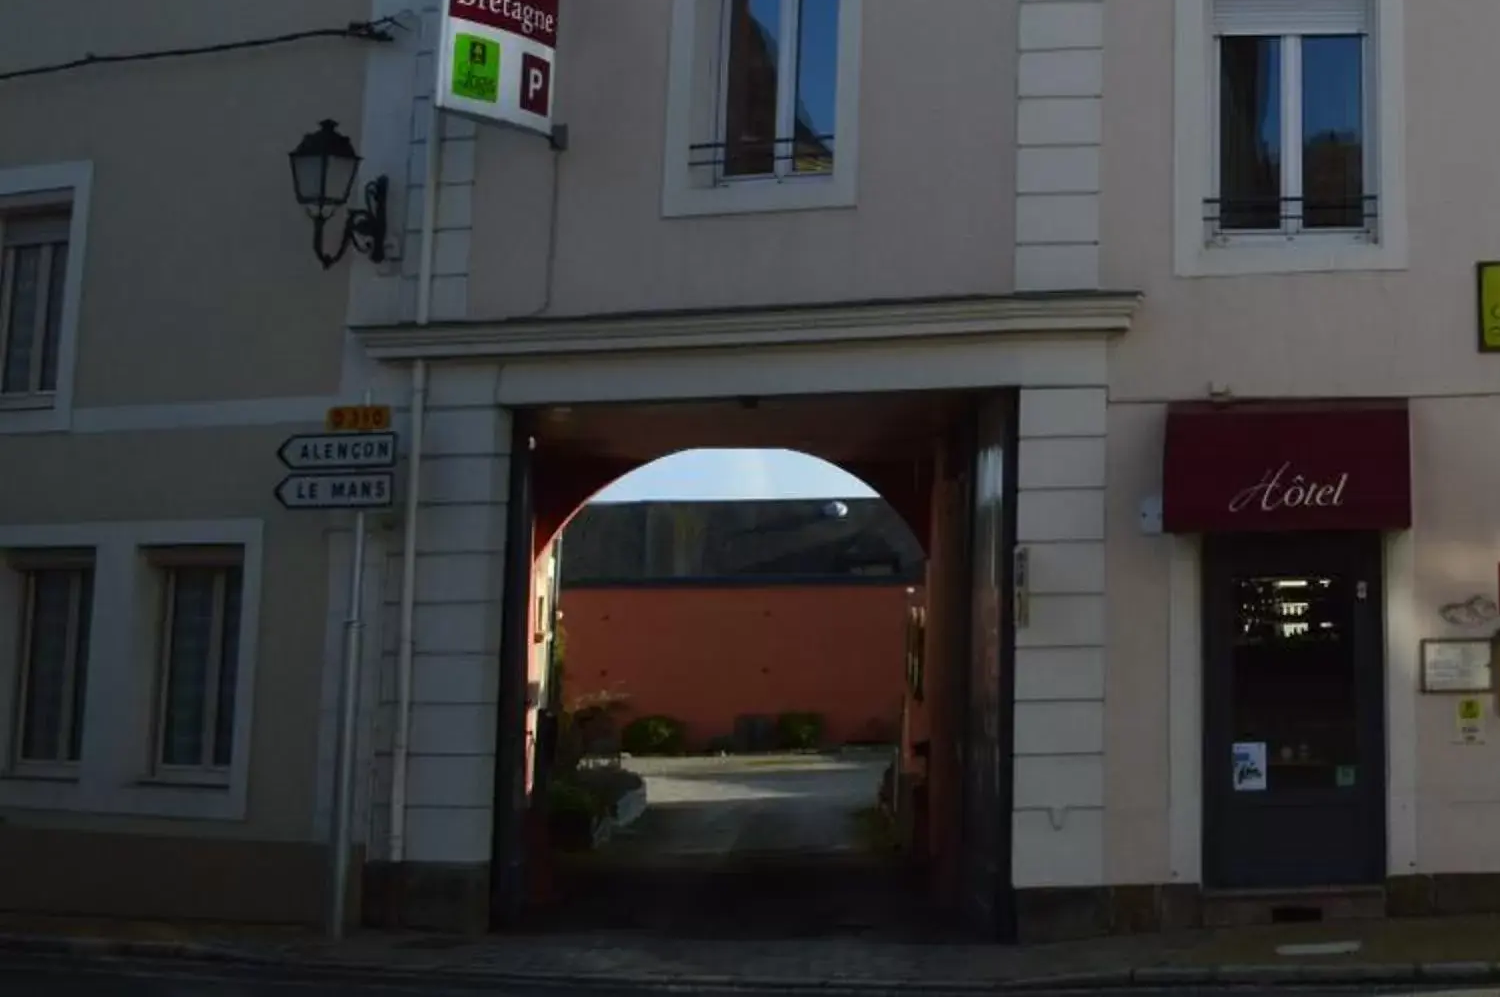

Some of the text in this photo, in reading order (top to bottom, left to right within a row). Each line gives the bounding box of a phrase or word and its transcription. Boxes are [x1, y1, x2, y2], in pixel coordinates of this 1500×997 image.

[528, 68, 543, 100] P
[296, 480, 386, 500] LE MANS
[1229, 460, 1350, 513] Hôtel
